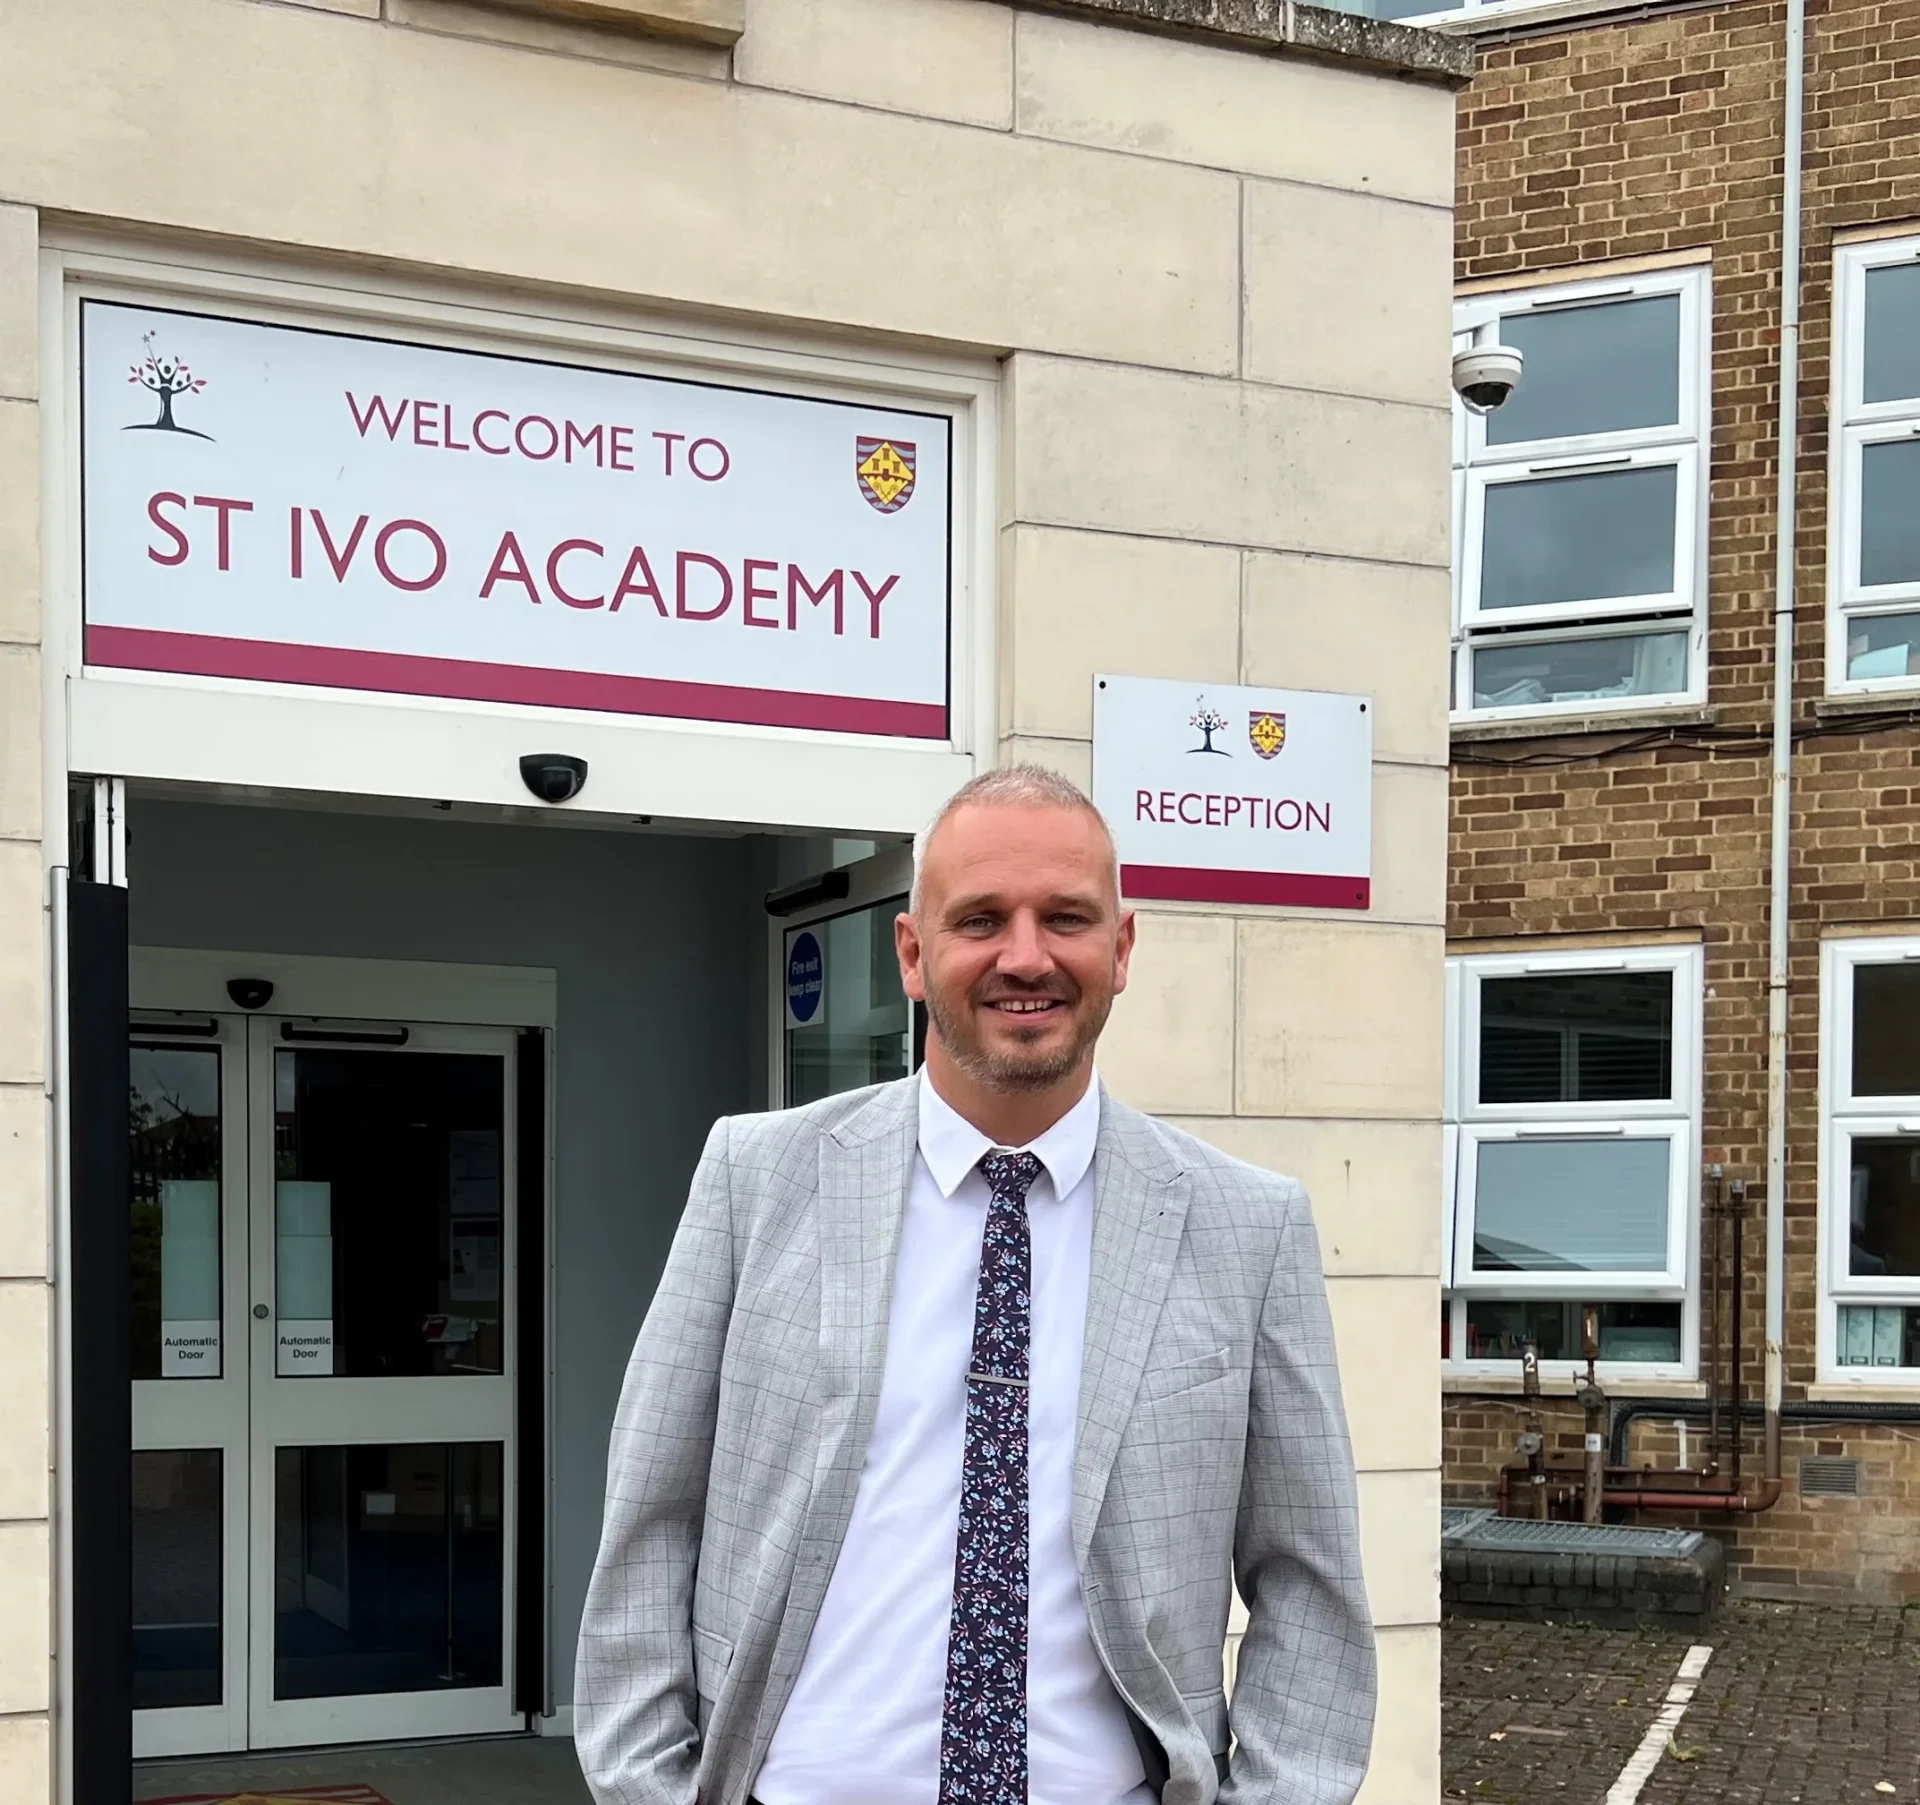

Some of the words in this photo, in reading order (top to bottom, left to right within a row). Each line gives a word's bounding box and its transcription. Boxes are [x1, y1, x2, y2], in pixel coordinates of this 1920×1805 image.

[346, 391, 634, 471] WELCOME
[653, 432, 731, 482] TO
[148, 491, 254, 571] ST
[290, 506, 447, 592] IVO
[479, 530, 901, 639] ACADEMY
[1136, 790, 1331, 833] RECEPTION
[792, 962, 804, 975] Fire
[805, 957, 818, 972] exit
[789, 984, 804, 999] keep
[805, 979, 822, 993] clear
[164, 1336, 219, 1347] Automatic
[279, 1335, 332, 1346] Automatic
[178, 1350, 205, 1360] Door
[292, 1349, 319, 1359] Door
[1524, 1352, 1535, 1372] 2
